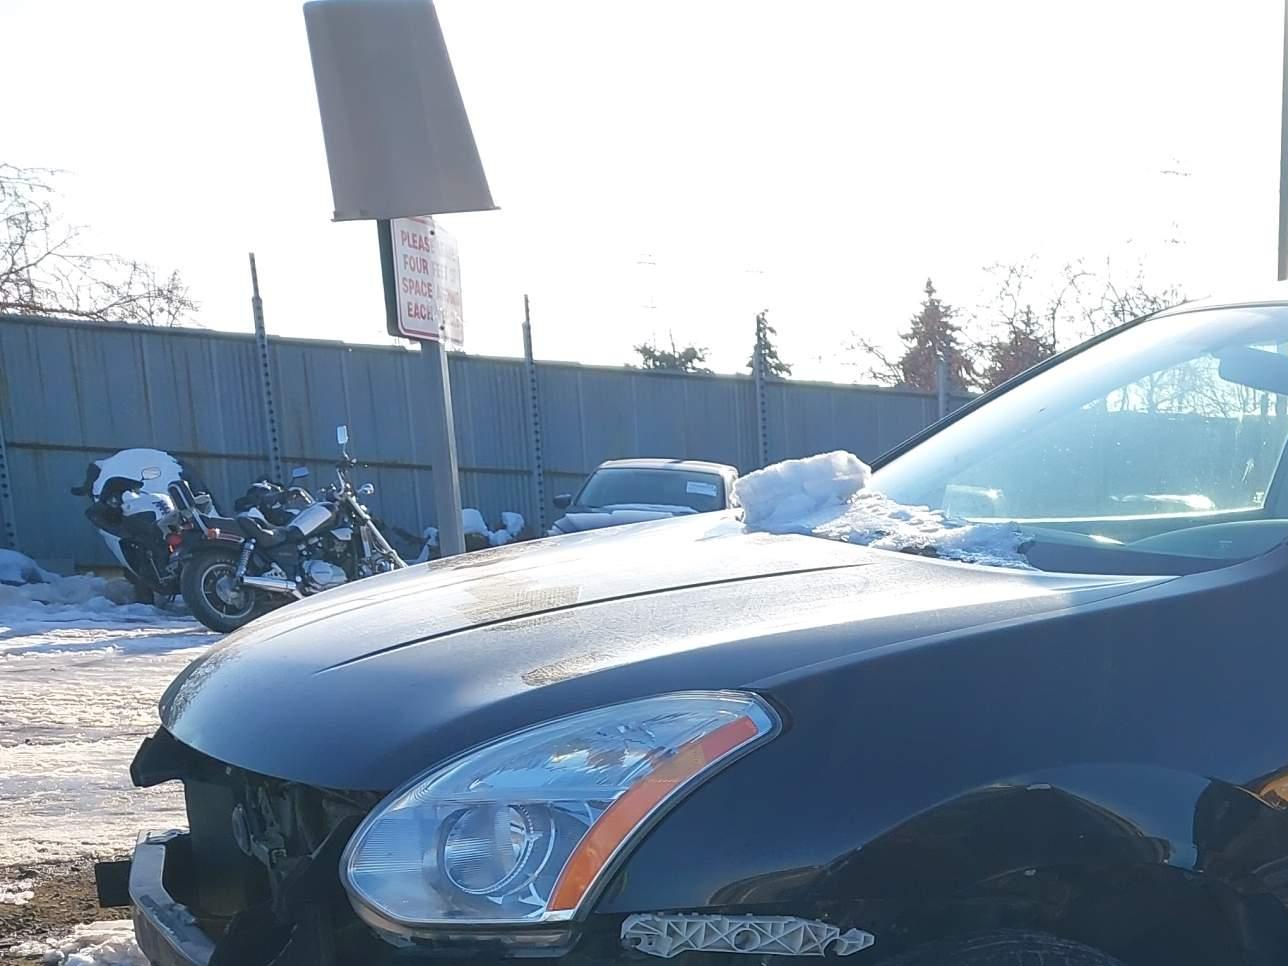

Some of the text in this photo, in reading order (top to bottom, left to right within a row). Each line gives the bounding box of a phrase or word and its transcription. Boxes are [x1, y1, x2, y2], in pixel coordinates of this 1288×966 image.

[403, 254, 429, 275] FOUR
[401, 277, 433, 298] SPACE
[407, 301, 434, 321] EACH
